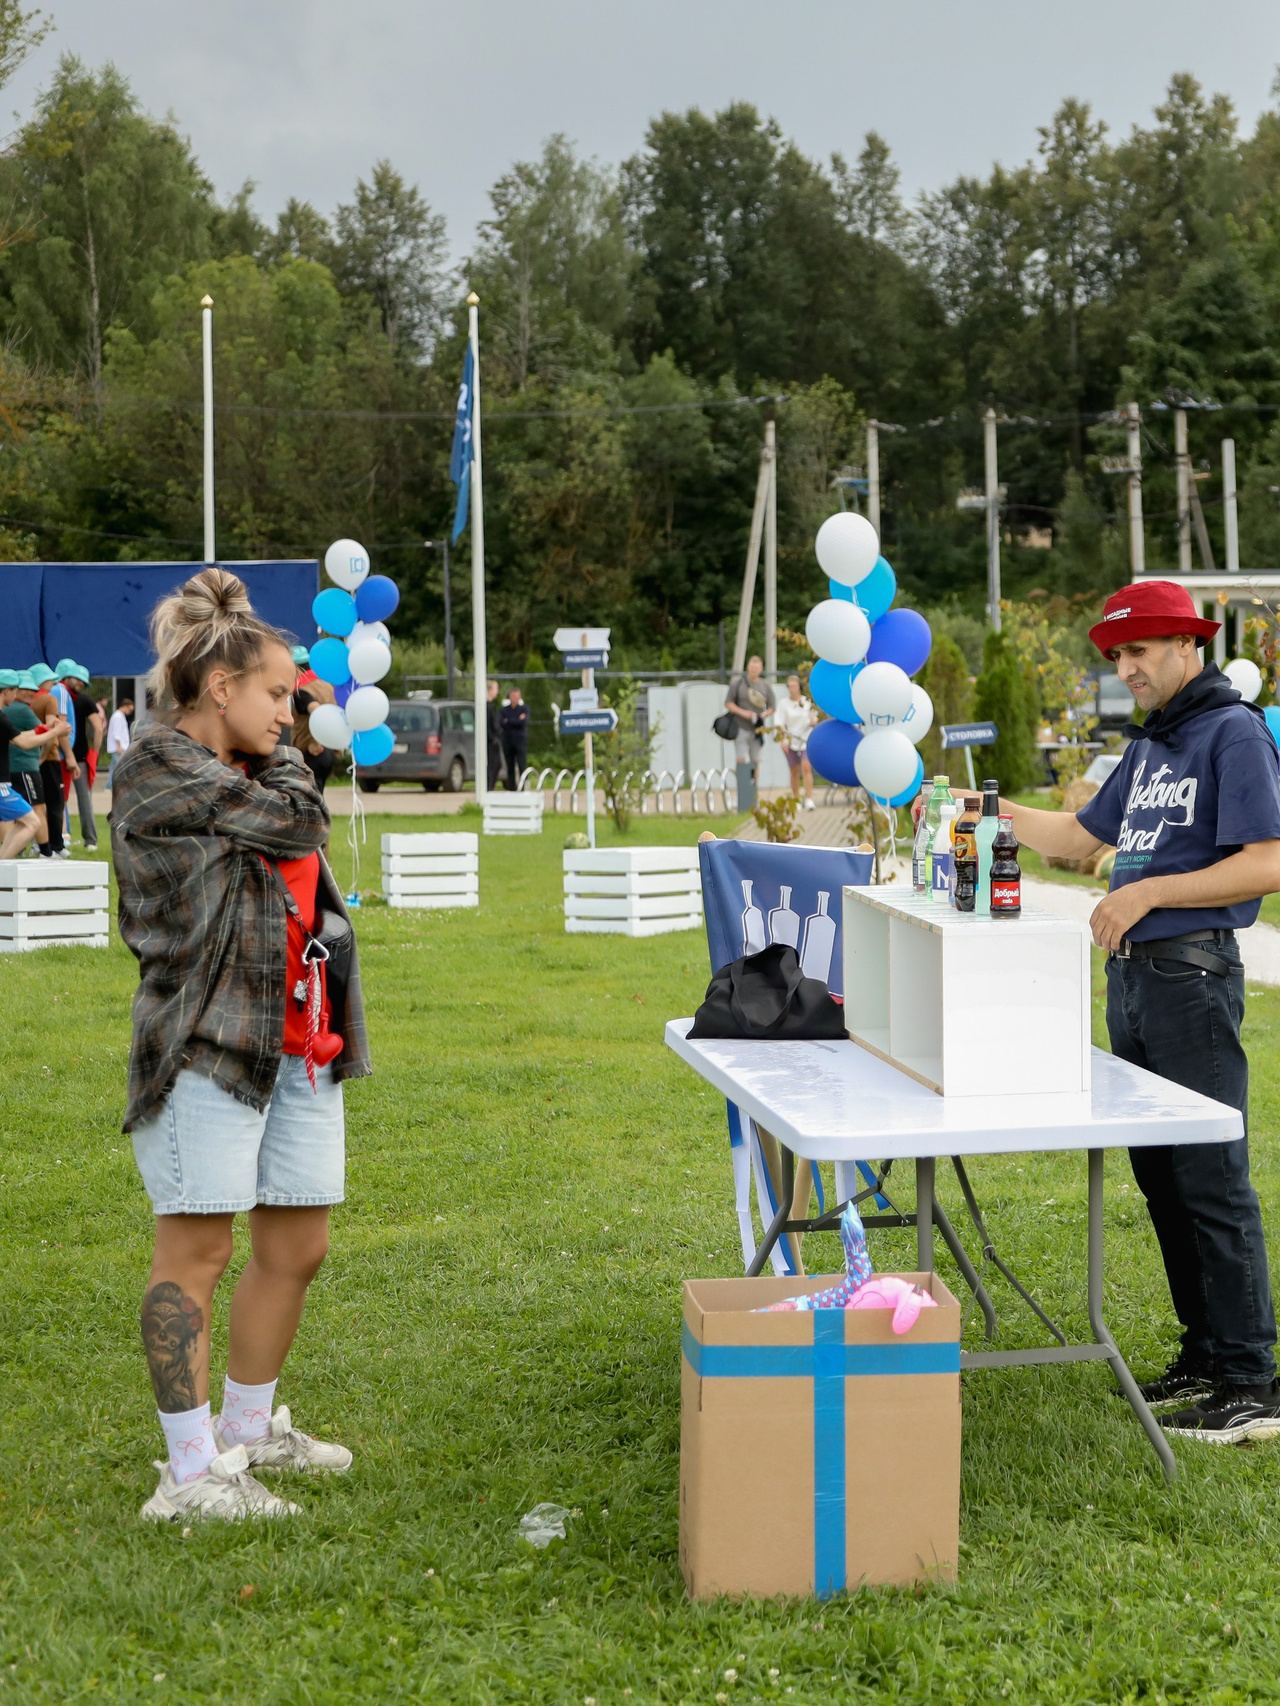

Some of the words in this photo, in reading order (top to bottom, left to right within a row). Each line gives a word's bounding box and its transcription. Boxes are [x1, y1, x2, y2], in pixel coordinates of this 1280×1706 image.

[948, 729, 995, 742] СТОЛОВКА
[1132, 854, 1152, 863] NORTH
[994, 888, 1019, 898] Добрый
